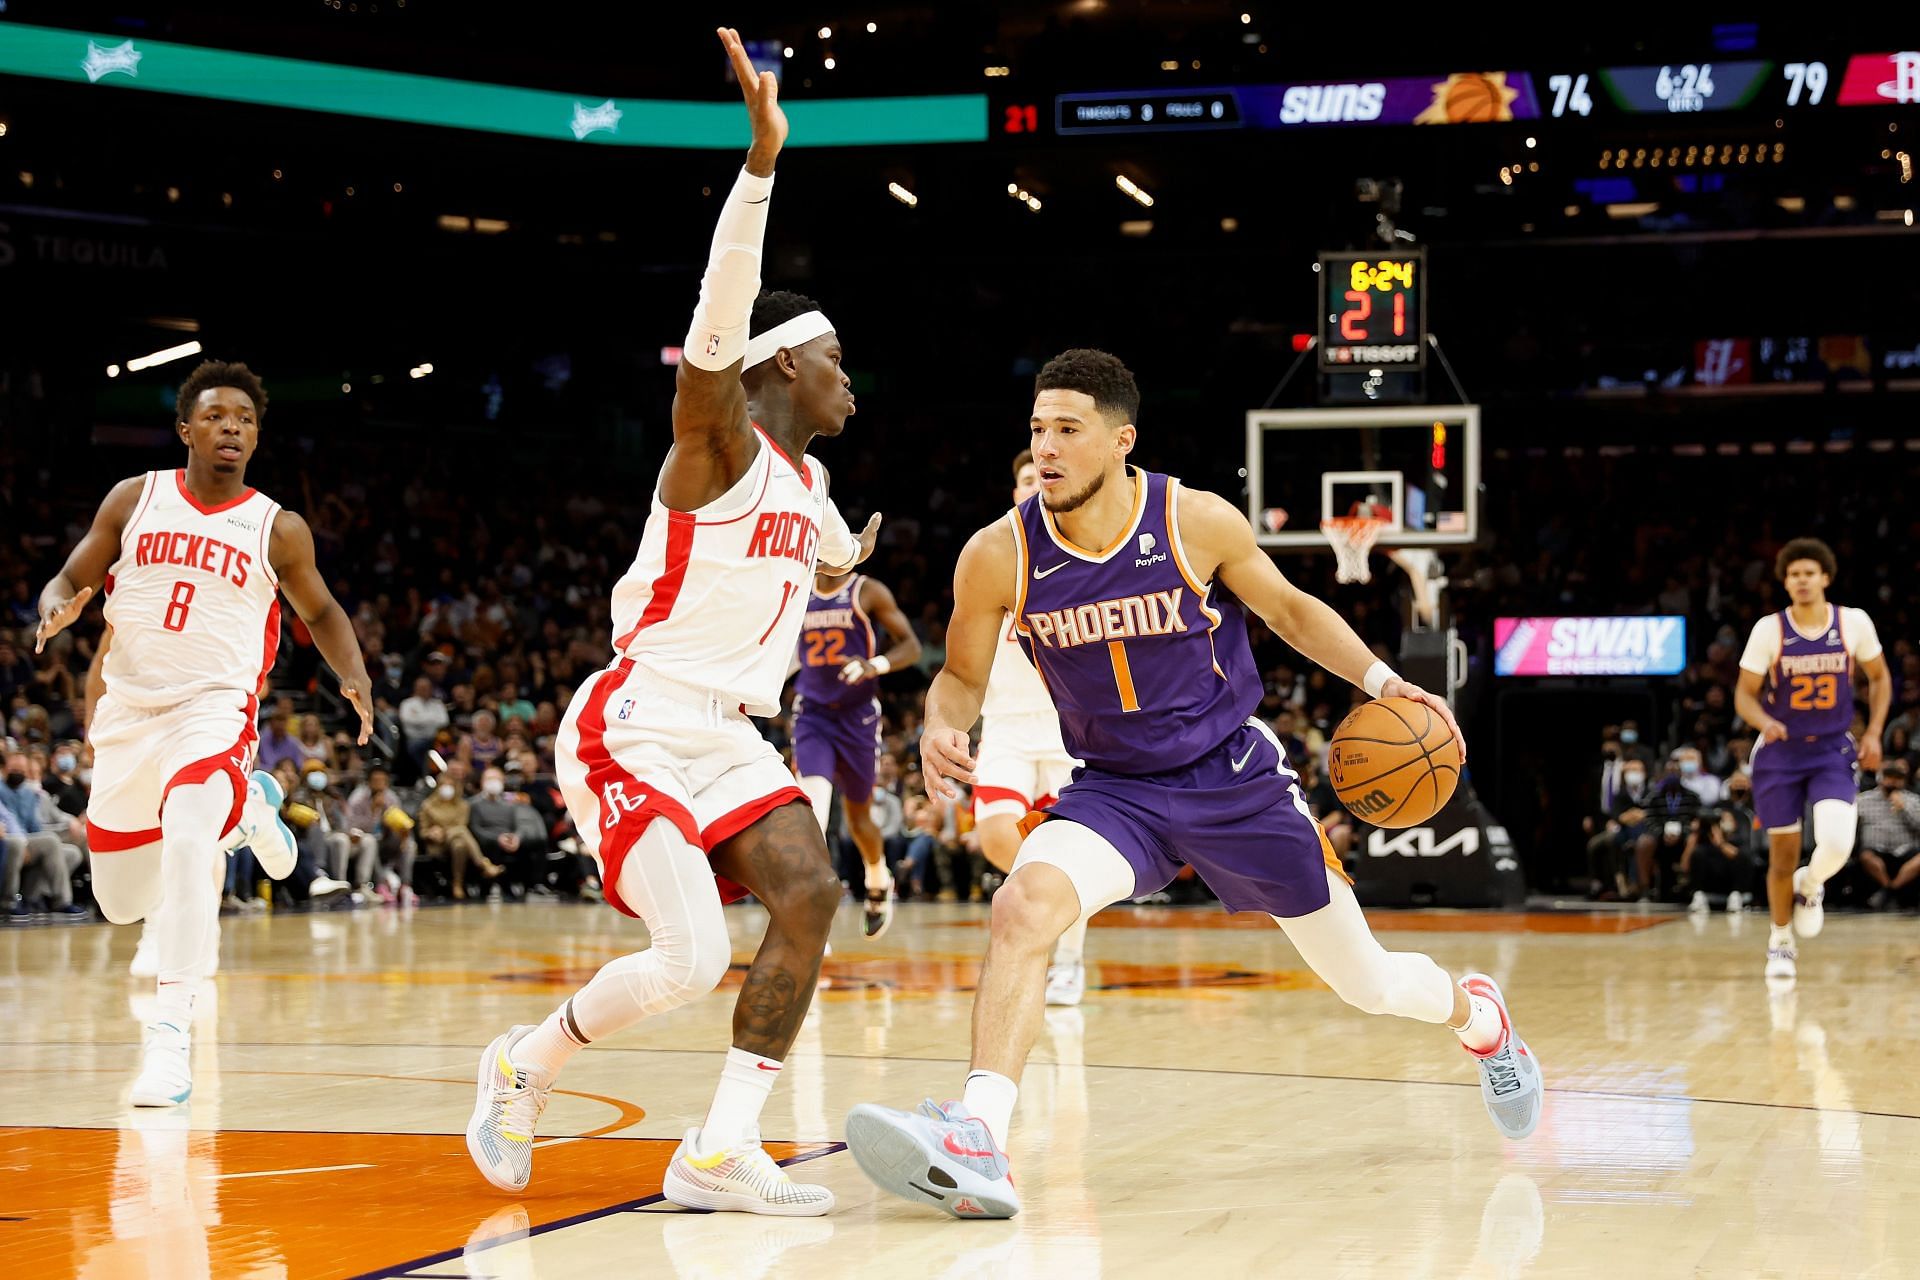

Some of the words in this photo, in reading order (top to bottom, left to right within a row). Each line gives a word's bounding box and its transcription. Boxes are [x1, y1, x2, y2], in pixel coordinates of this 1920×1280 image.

[1549, 74, 1593, 117] 74
[1655, 64, 1715, 100] 6:24
[1784, 62, 1828, 106] 79
[1005, 105, 1037, 133] 21
[1280, 83, 1386, 124] SUNS
[33, 233, 168, 271] TEQUILA
[1350, 260, 1413, 292] 6:24
[1341, 290, 1405, 341] 21
[226, 517, 258, 534] MONEY
[746, 511, 821, 573] ROCKET
[136, 531, 252, 589] ROCKETS
[1135, 552, 1167, 568] PayPal
[163, 581, 196, 632] 8
[759, 580, 800, 645] 1
[1026, 586, 1188, 649] PHOENIX
[804, 628, 847, 668] 22
[1547, 617, 1677, 661] SWAY
[1107, 639, 1142, 713] 1
[1547, 656, 1648, 675] ENERGY
[1781, 651, 1848, 678] PHOENIX
[1790, 674, 1837, 710] 23
